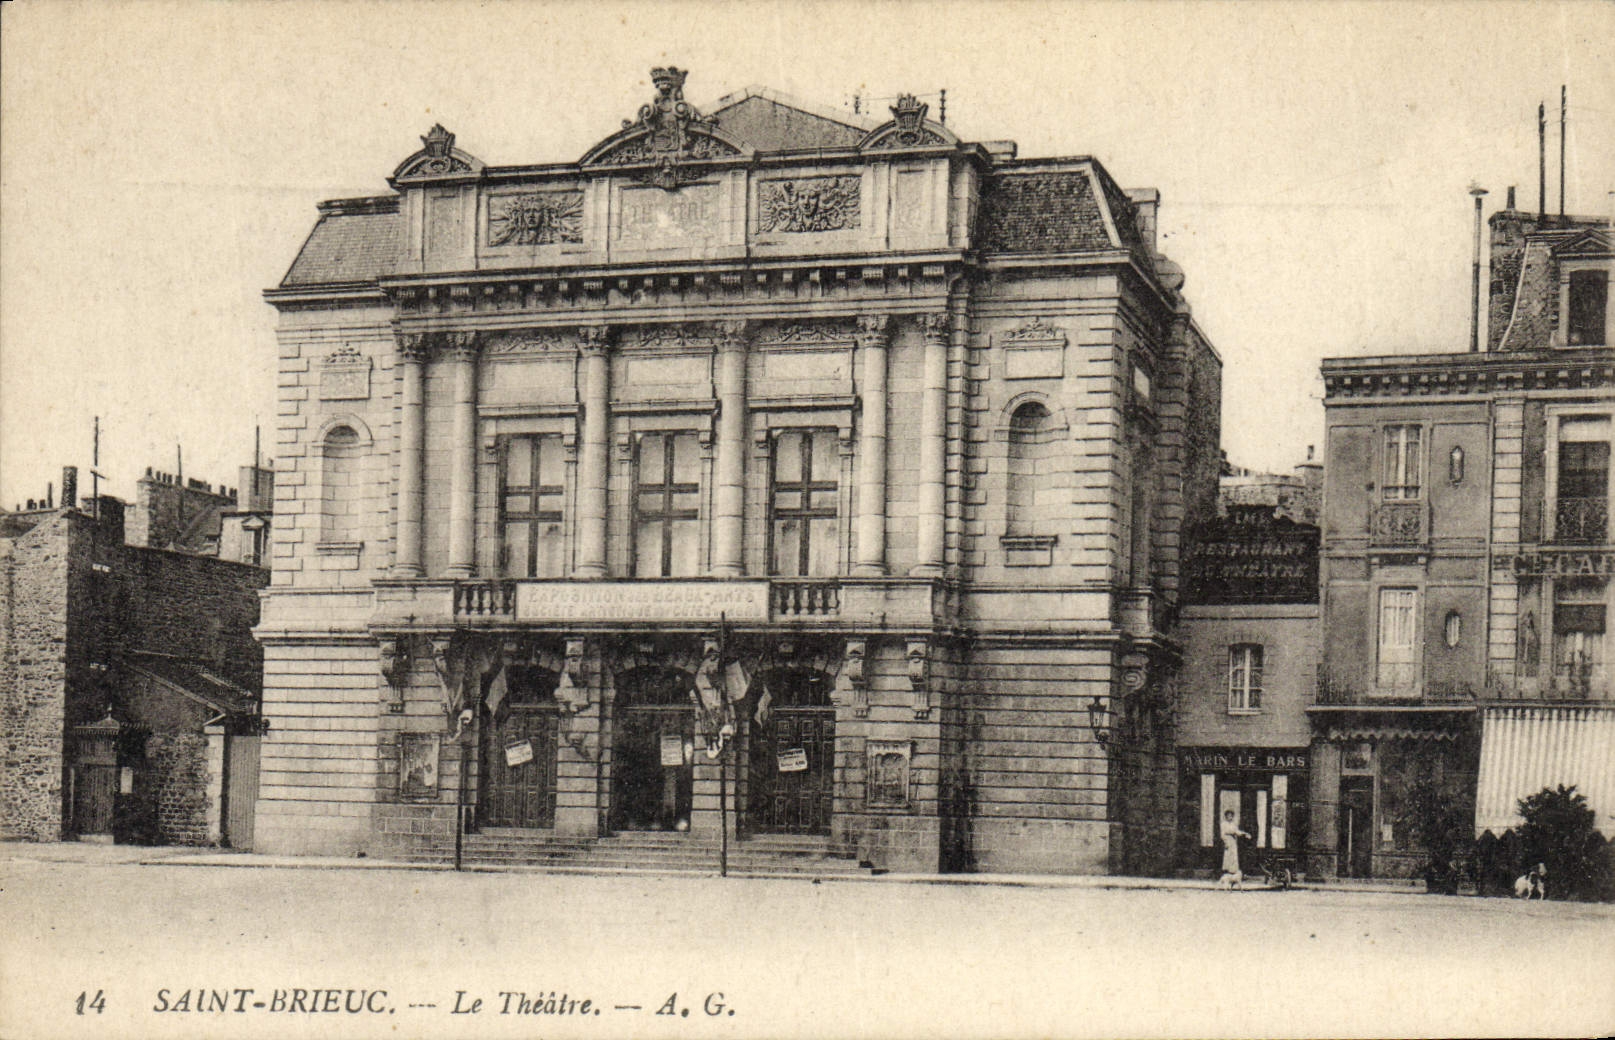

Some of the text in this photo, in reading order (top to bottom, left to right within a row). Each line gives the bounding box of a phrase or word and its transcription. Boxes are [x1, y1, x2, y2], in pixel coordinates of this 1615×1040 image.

[528, 586, 625, 603] EXPOSITION
[1238, 755, 1257, 767] LE
[1267, 755, 1306, 768] BARS
